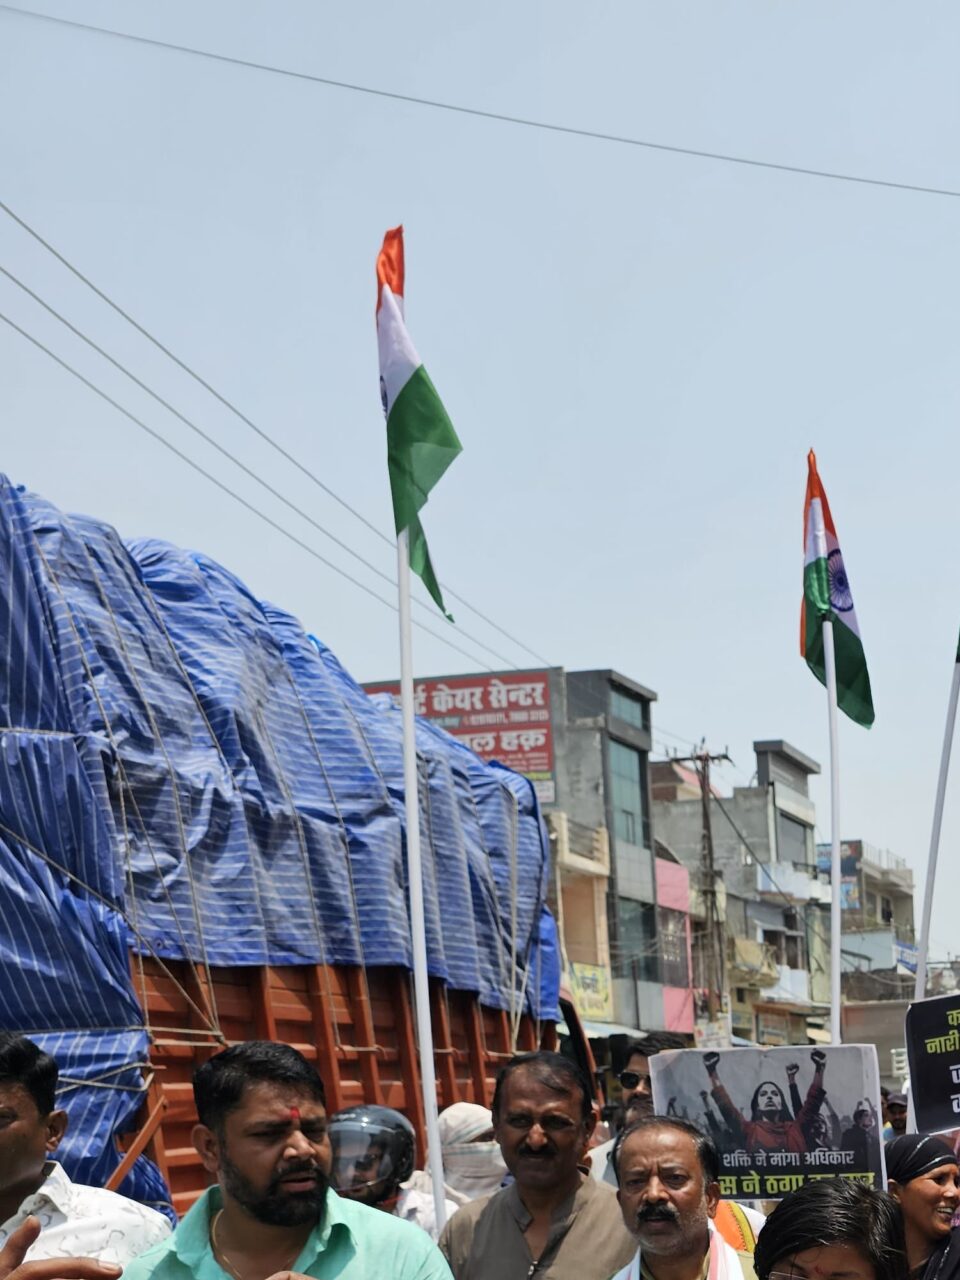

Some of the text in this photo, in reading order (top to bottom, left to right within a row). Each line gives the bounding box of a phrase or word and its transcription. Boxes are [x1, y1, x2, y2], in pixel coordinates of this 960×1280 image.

[431, 684, 484, 712] केयर
[924, 1030, 960, 1054] नारी
[723, 1147, 855, 1167] शक्ति ने मांगा अधिकार
[741, 1170, 761, 1194] ने
[764, 1174, 804, 1195] ठगा
